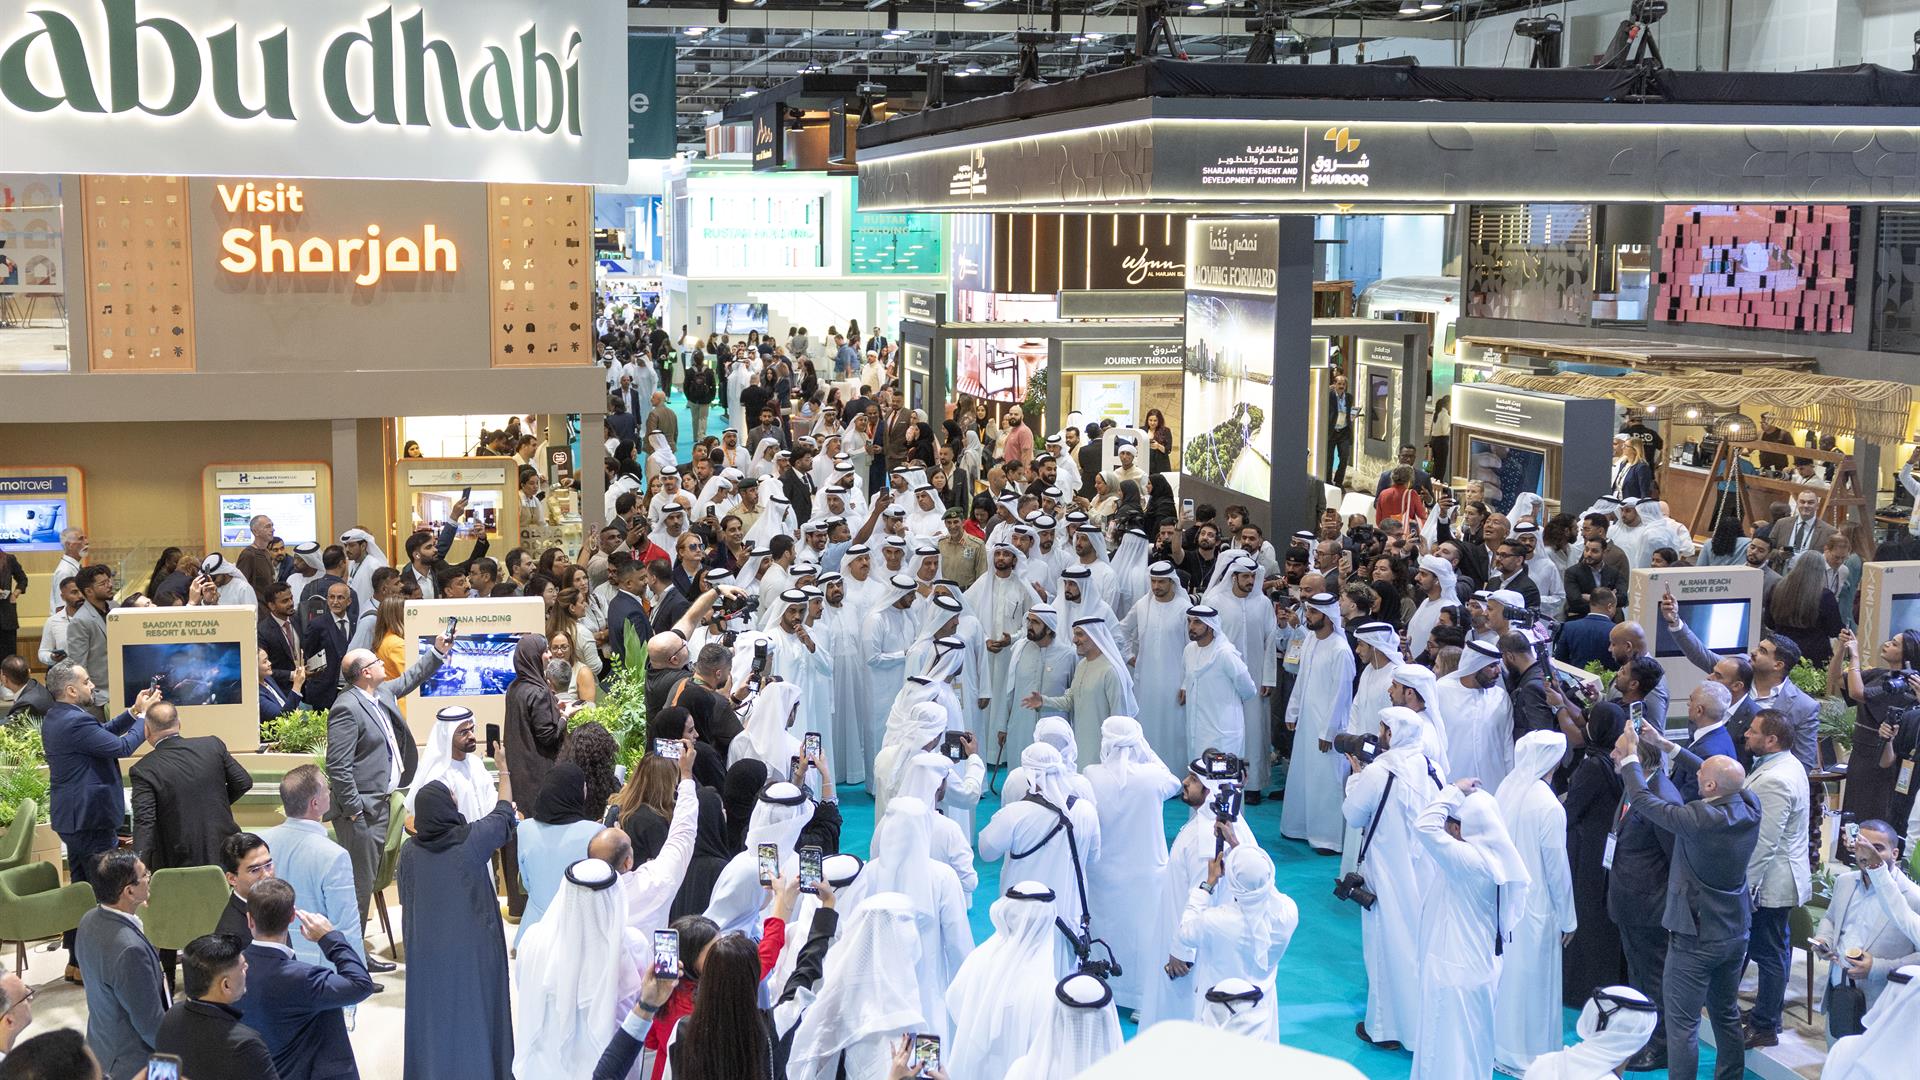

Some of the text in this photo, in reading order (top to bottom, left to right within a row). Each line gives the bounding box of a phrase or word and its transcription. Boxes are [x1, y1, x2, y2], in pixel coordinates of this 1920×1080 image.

[0, 0, 583, 137] abu dhabi
[1202, 167, 1298, 175] SHARJAH INVESTMENT AND
[1202, 176, 1297, 185] DEVELOPMENT AUTHORITY
[1311, 174, 1369, 187] SHUROOQ
[217, 183, 304, 213] Visit
[219, 224, 458, 286] Sharjah
[1194, 265, 1276, 288] MOVING FORWARD
[1104, 356, 1142, 365] JOURNEY
[475, 614, 512, 623] HOLDING
[142, 620, 219, 629] SAADIYAT ROTANA
[146, 629, 179, 637] RESORT
[188, 628, 217, 636] VILLAS
